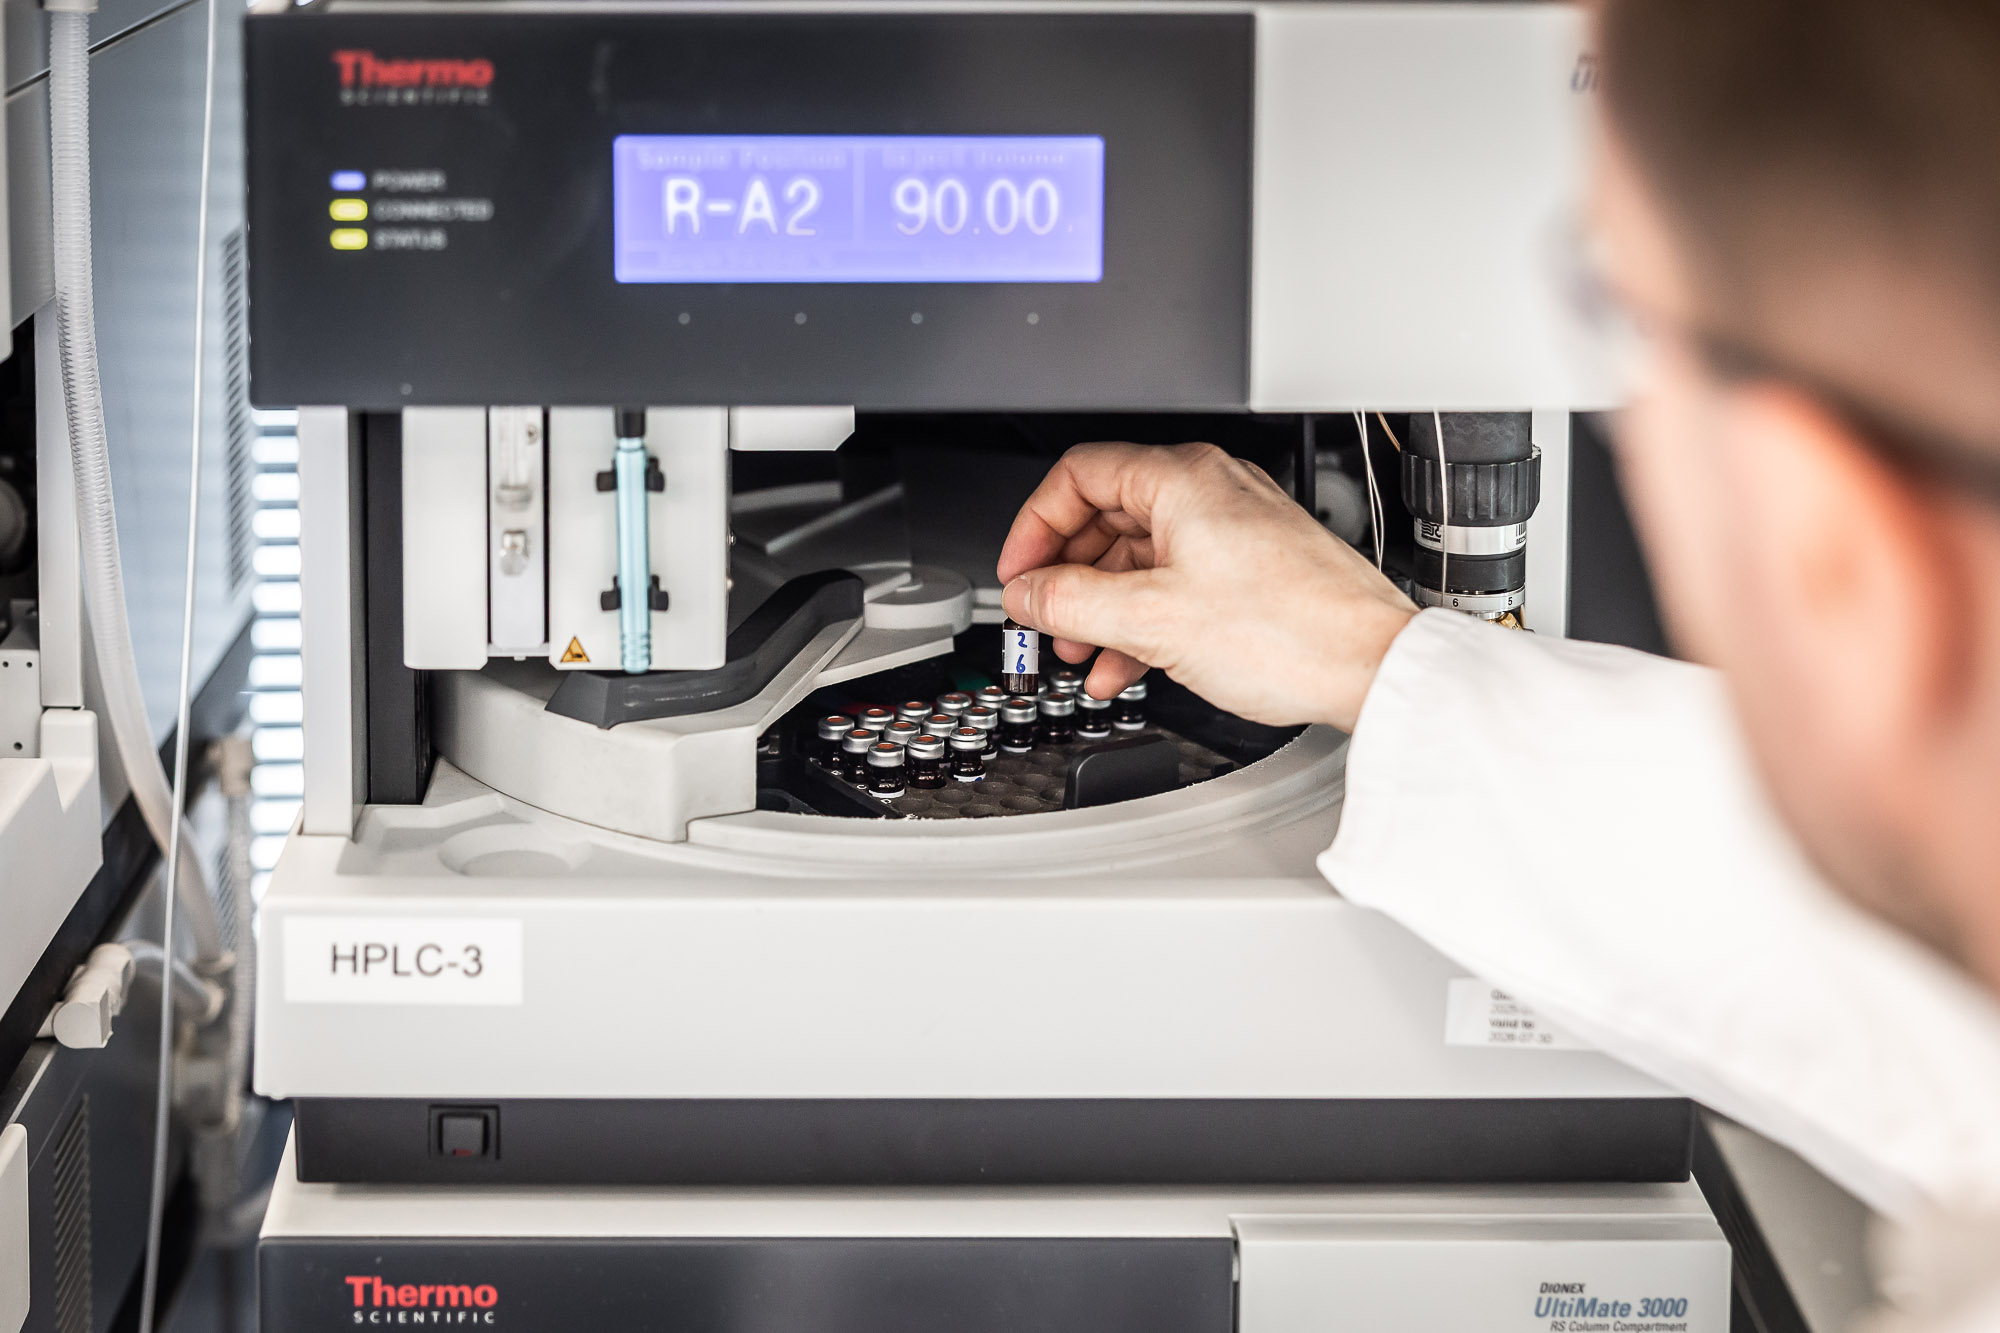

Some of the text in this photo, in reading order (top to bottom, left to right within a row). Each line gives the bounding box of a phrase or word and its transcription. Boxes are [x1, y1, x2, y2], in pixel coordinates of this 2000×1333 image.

[332, 50, 494, 87] Thermo
[665, 178, 819, 236] R-A2
[896, 178, 1061, 236] 90.00
[1452, 598, 1459, 607] 6
[1507, 596, 1513, 606] 5
[1017, 631, 1028, 648] 2
[1015, 653, 1026, 674] 6
[331, 943, 483, 977] HPLC-3
[344, 1275, 498, 1307] Thermo
[1540, 1282, 1585, 1294] DIONEX
[353, 1310, 495, 1324] SCIENTIFIC
[1534, 1296, 1688, 1318] UltiMate 3000
[1550, 1320, 1688, 1333] RS Column Compartment
